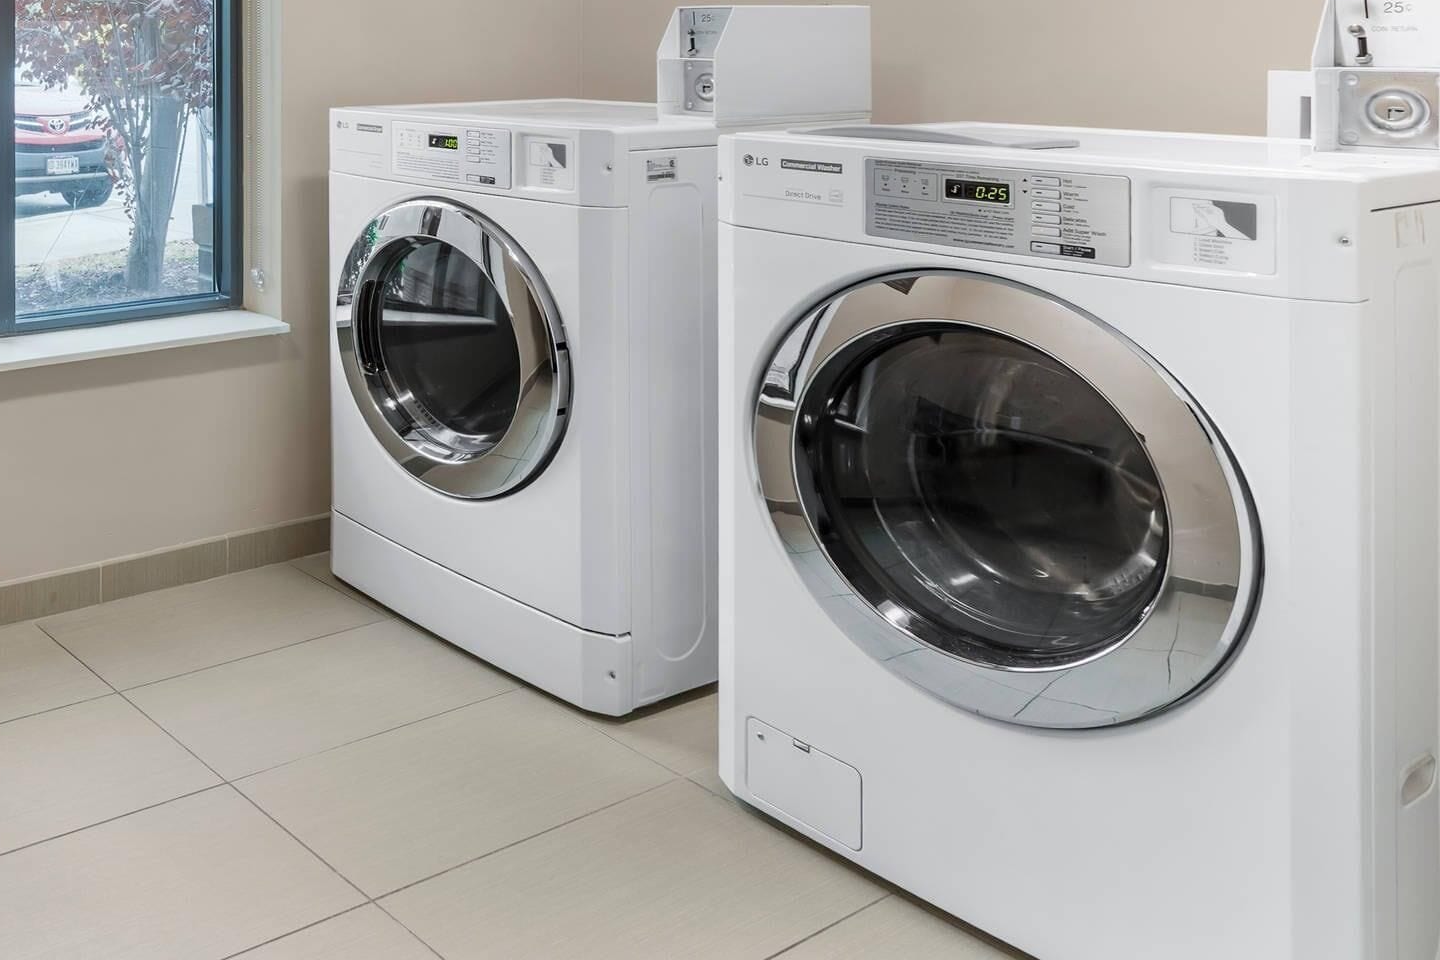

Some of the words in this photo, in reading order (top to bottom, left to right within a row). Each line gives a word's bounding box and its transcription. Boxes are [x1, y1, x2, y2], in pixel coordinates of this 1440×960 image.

[755, 157, 769, 166] LG
[784, 189, 803, 198] Direct
[804, 191, 822, 200] Drive
